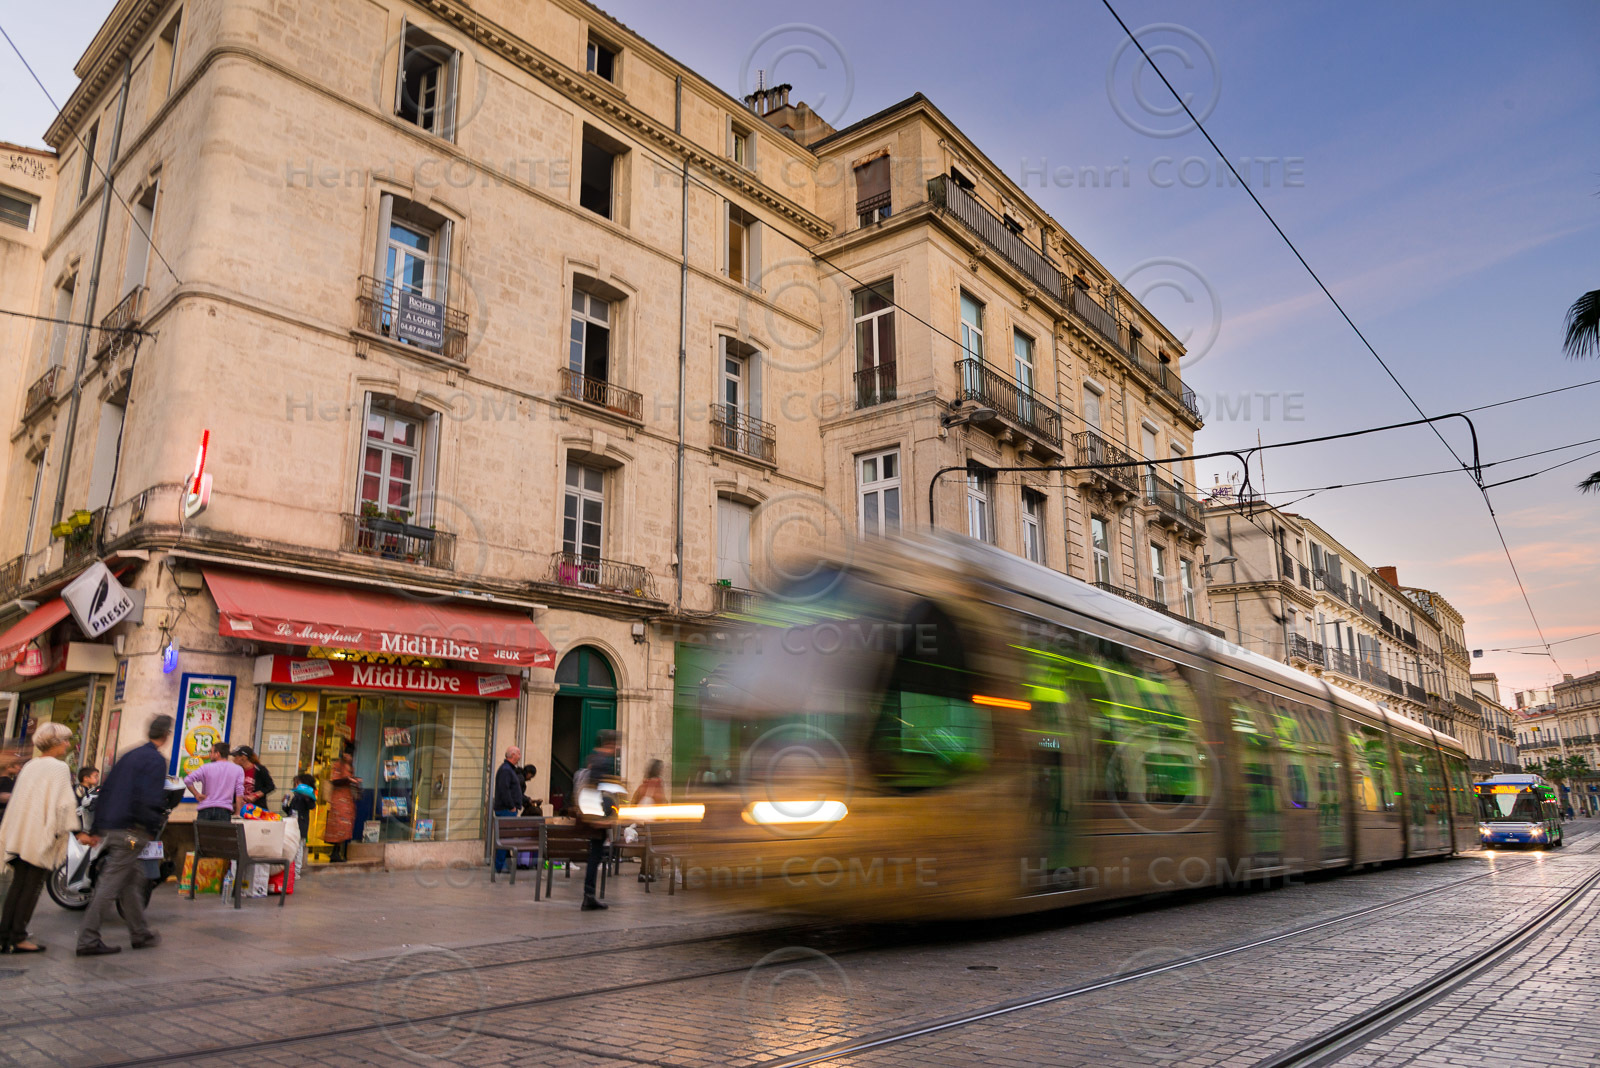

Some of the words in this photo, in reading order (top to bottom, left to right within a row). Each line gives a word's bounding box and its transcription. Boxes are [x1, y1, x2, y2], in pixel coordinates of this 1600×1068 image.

[413, 314, 437, 328] LOUER
[92, 596, 130, 632] PRESSE
[274, 622, 294, 637] Le
[296, 624, 362, 645] Maryland
[493, 649, 520, 661] JEUX
[194, 734, 213, 752] 13
